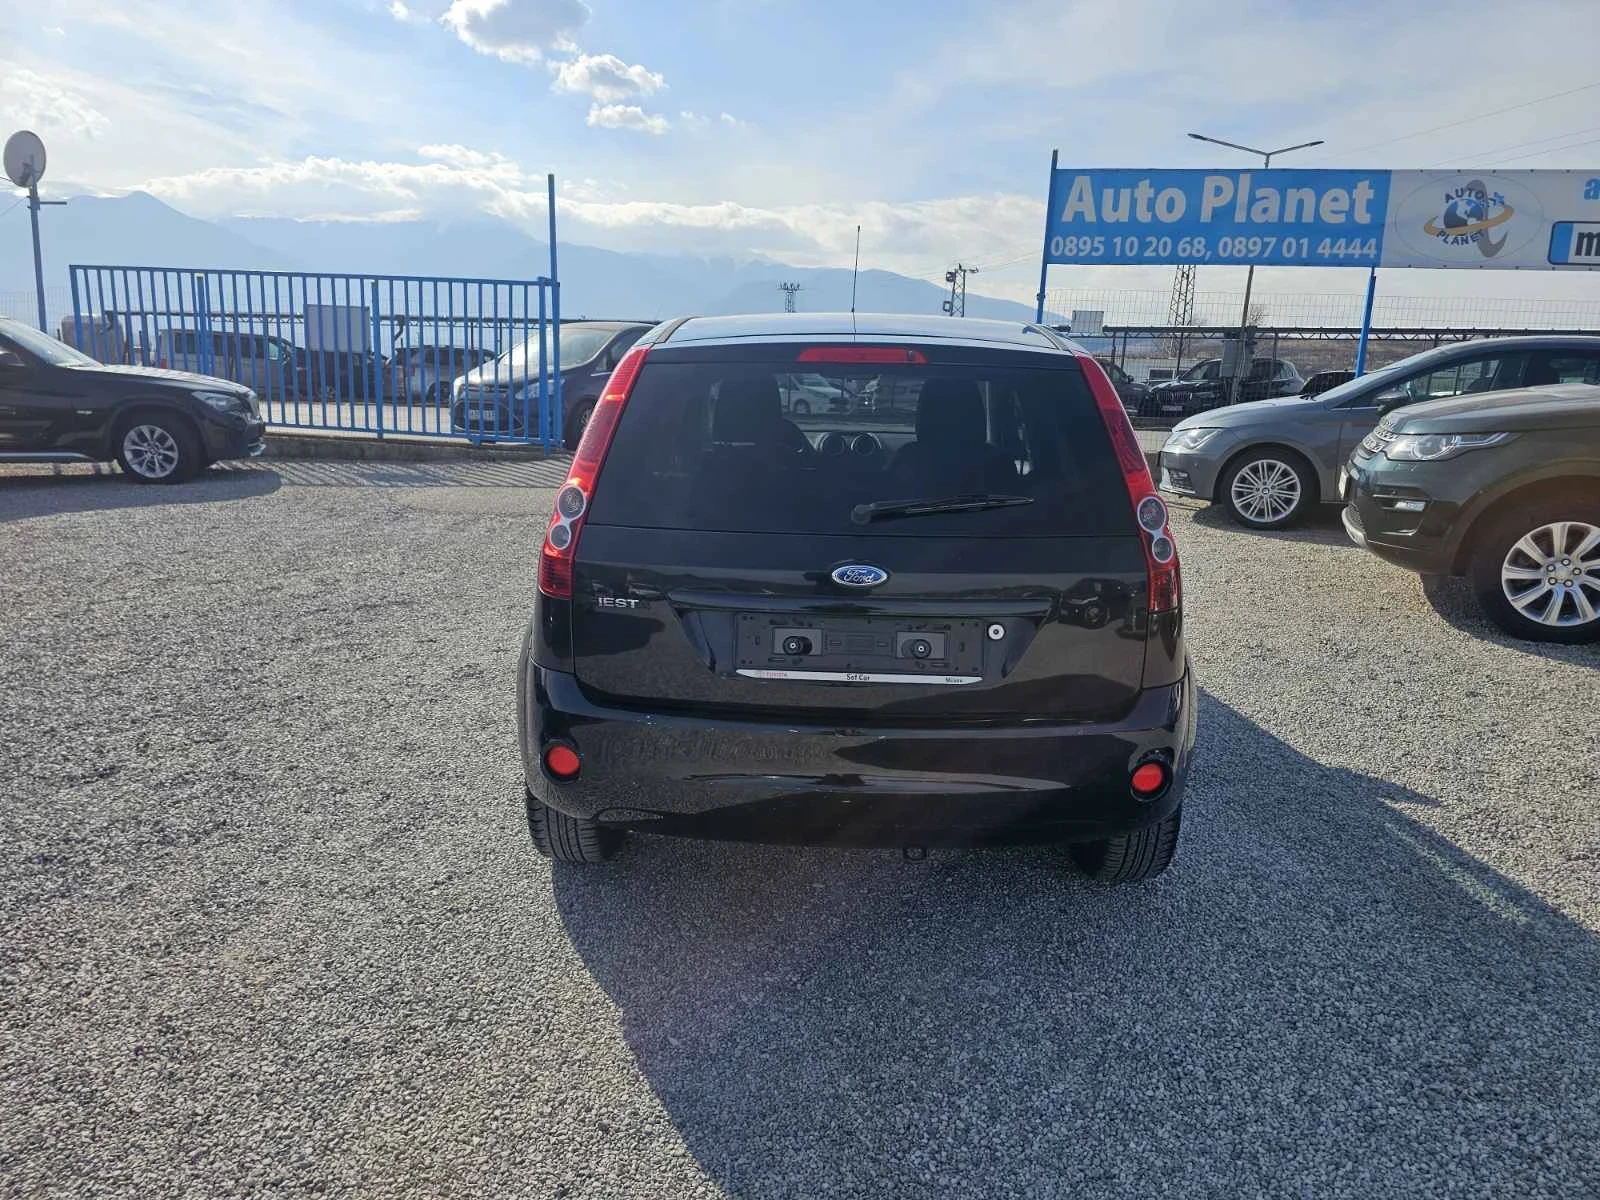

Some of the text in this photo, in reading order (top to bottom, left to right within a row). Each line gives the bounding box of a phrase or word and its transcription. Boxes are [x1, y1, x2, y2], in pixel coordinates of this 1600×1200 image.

[1061, 173, 1375, 224] Auto Planet
[1444, 187, 1485, 204] AUTO
[1051, 236, 1377, 261] 0895 10 20 68, 0897 01 4444
